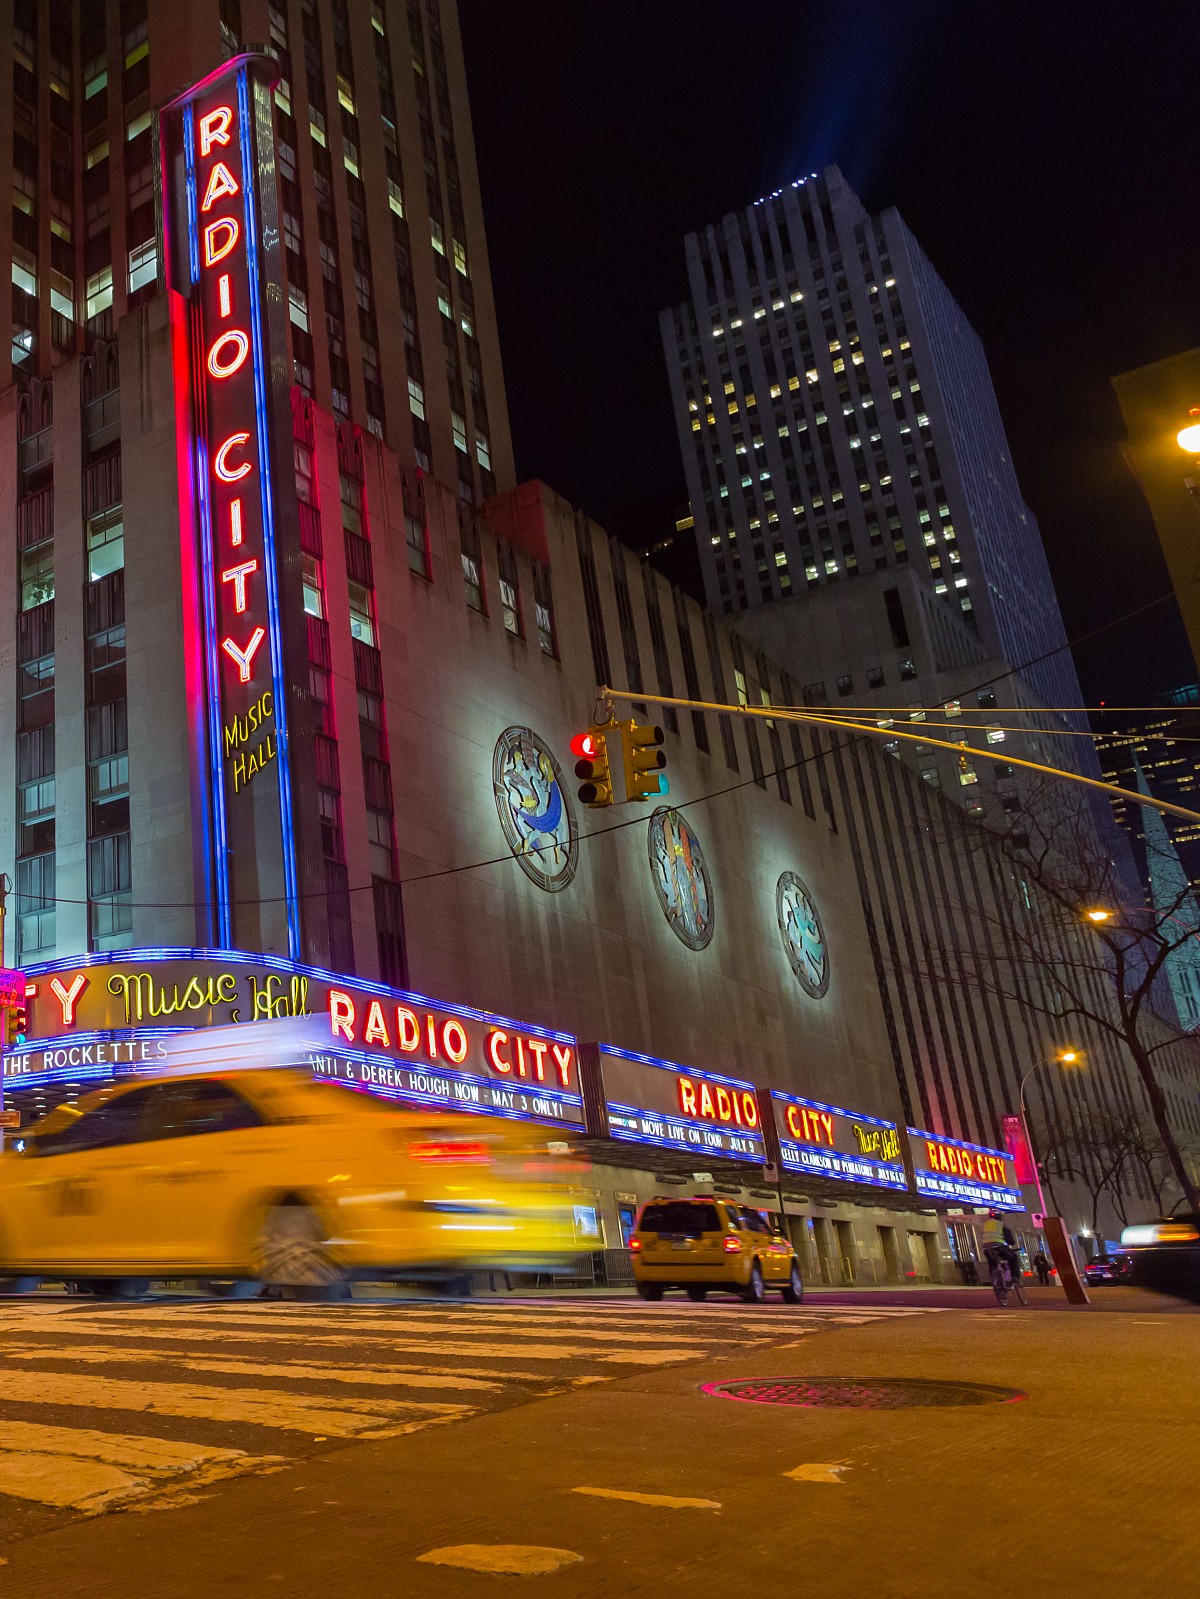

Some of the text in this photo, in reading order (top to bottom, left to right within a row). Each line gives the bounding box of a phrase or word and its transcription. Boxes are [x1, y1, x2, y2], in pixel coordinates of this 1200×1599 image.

[200, 106, 265, 682] RADIO CITY
[106, 971, 313, 1024] Music Hall
[2, 1054, 31, 1075] THE
[43, 1041, 169, 1070] ROCKETTES
[328, 988, 573, 1087] RADIO CITY
[303, 1053, 338, 1076] ANTI
[346, 1061, 355, 1079] &
[361, 1063, 403, 1087] DEREK
[409, 1073, 450, 1097] HOUGH
[454, 1082, 479, 1102] NOW
[491, 1089, 514, 1108] MAY
[520, 1095, 528, 1111] 3
[532, 1098, 563, 1118] ONLY!
[678, 1077, 758, 1127] RADIO
[641, 1119, 666, 1137] MOVE
[668, 1124, 686, 1143] LIVE
[688, 1129, 701, 1144] ON
[703, 1131, 723, 1147] TOUR
[730, 1137, 746, 1152] JULY
[749, 1141, 755, 1153] 9
[786, 1105, 834, 1146] CITY
[926, 1141, 1007, 1184] RADIO CITY
